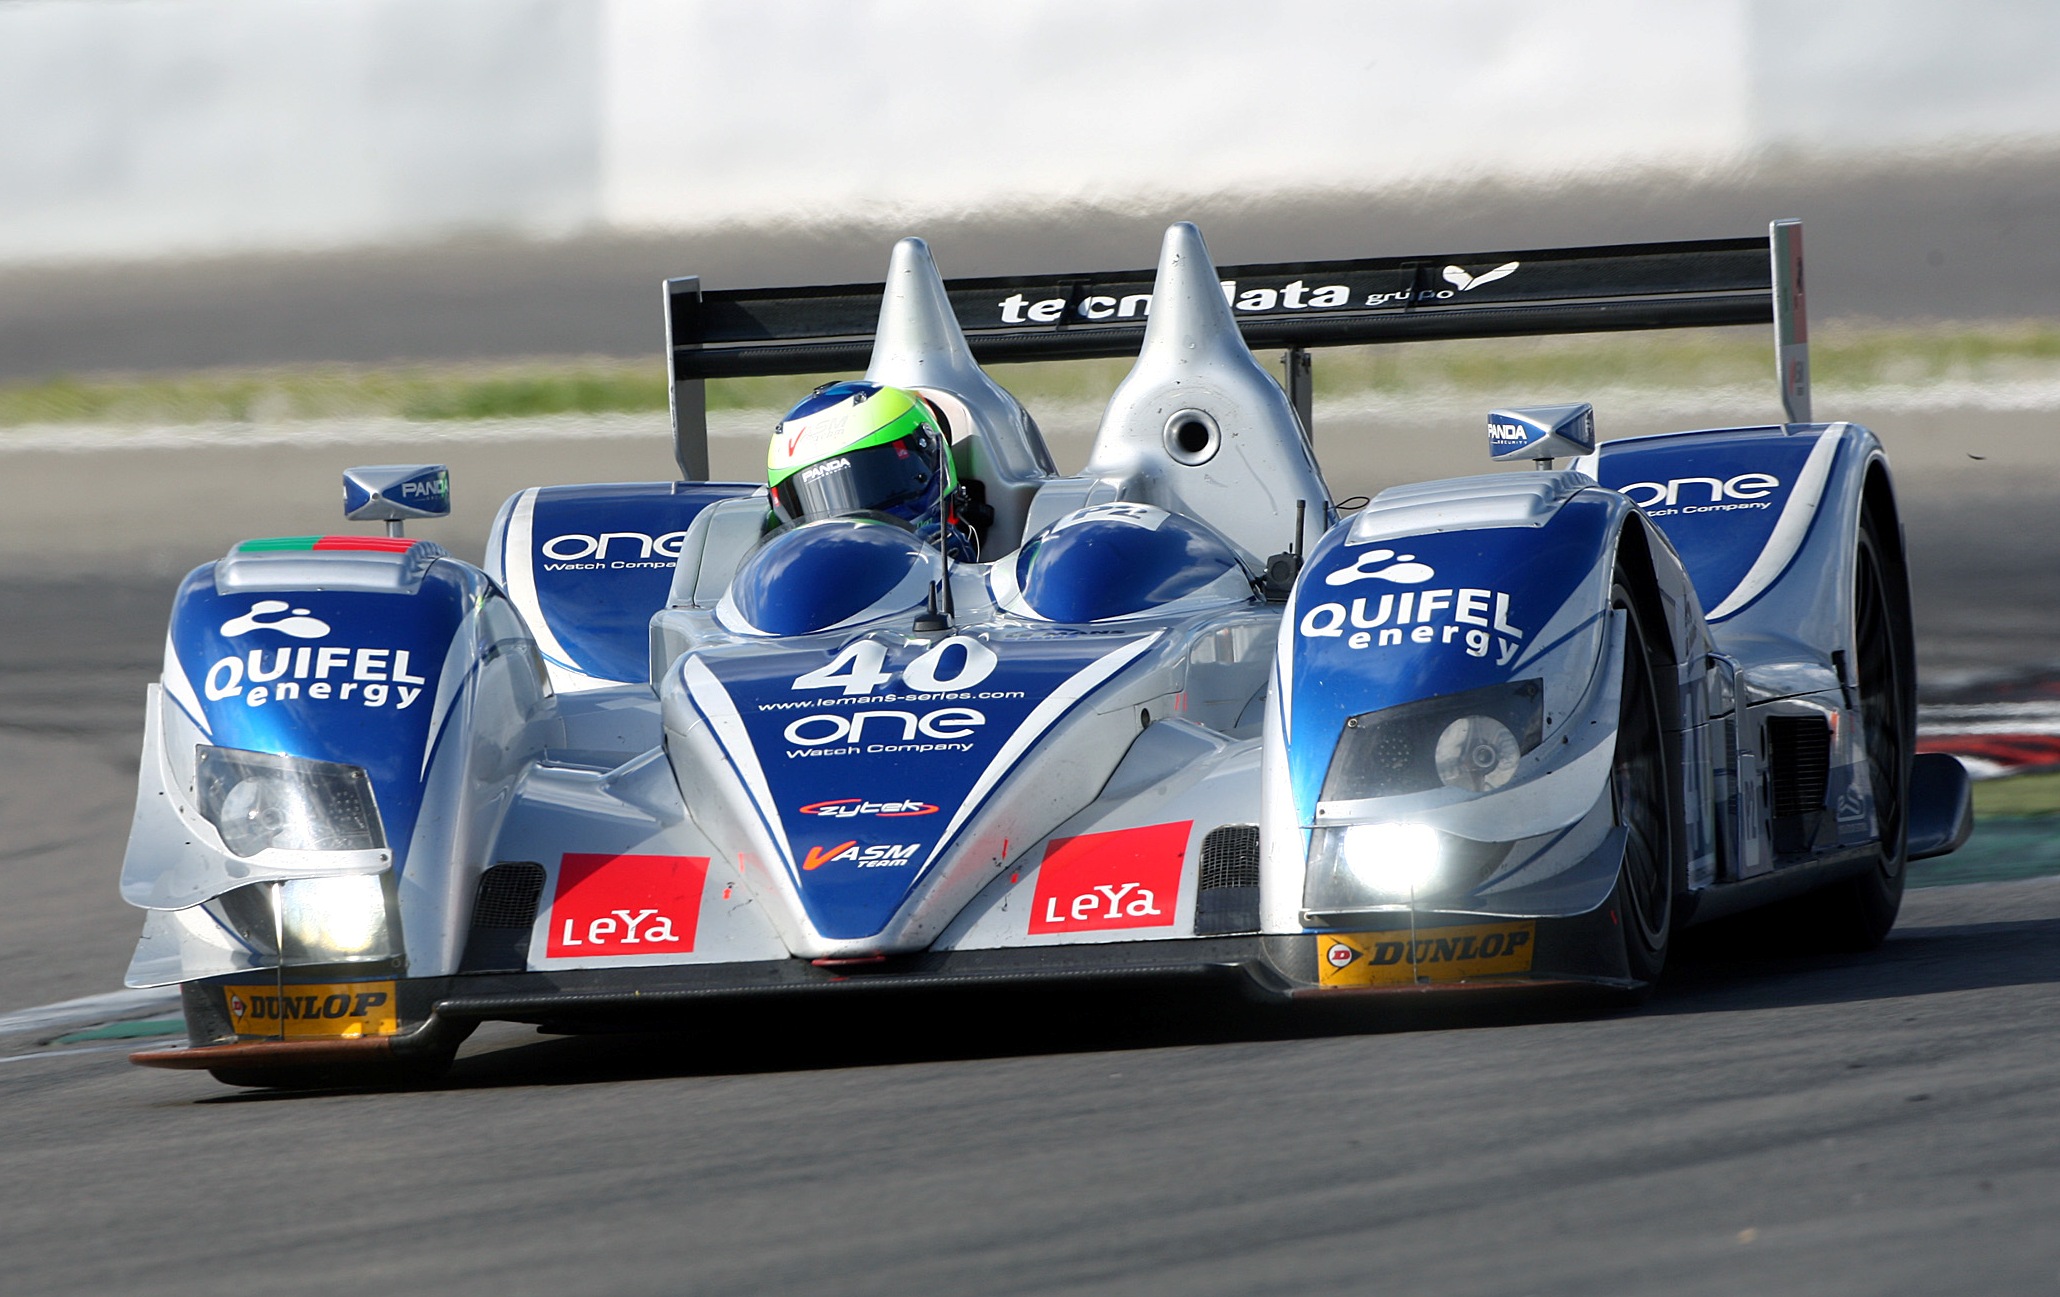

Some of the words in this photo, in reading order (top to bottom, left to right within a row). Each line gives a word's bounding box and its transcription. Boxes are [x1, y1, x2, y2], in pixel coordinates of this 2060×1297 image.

[1488, 424, 1527, 440] PANDA
[802, 457, 851, 483] PANDA
[1617, 473, 1779, 508] one
[1681, 501, 1772, 515] Company
[542, 531, 687, 561] one
[544, 560, 606, 571] Watch
[611, 560, 677, 569] Compa
[1300, 588, 1523, 638] QUIFEL
[1348, 625, 1520, 666] energy
[204, 647, 425, 701] QUIFEL
[791, 635, 998, 696] 40
[246, 681, 422, 709] energy
[758, 690, 1025, 711] www.lemans-series.com
[783, 707, 986, 746] one
[786, 746, 860, 759] Watch
[867, 742, 974, 753] Company
[857, 858, 908, 868] TEAM
[1045, 882, 1161, 923] LeYa
[562, 908, 680, 946] LeYa
[1368, 930, 1530, 966] DUNLOP
[250, 991, 388, 1020] DUNLOP
